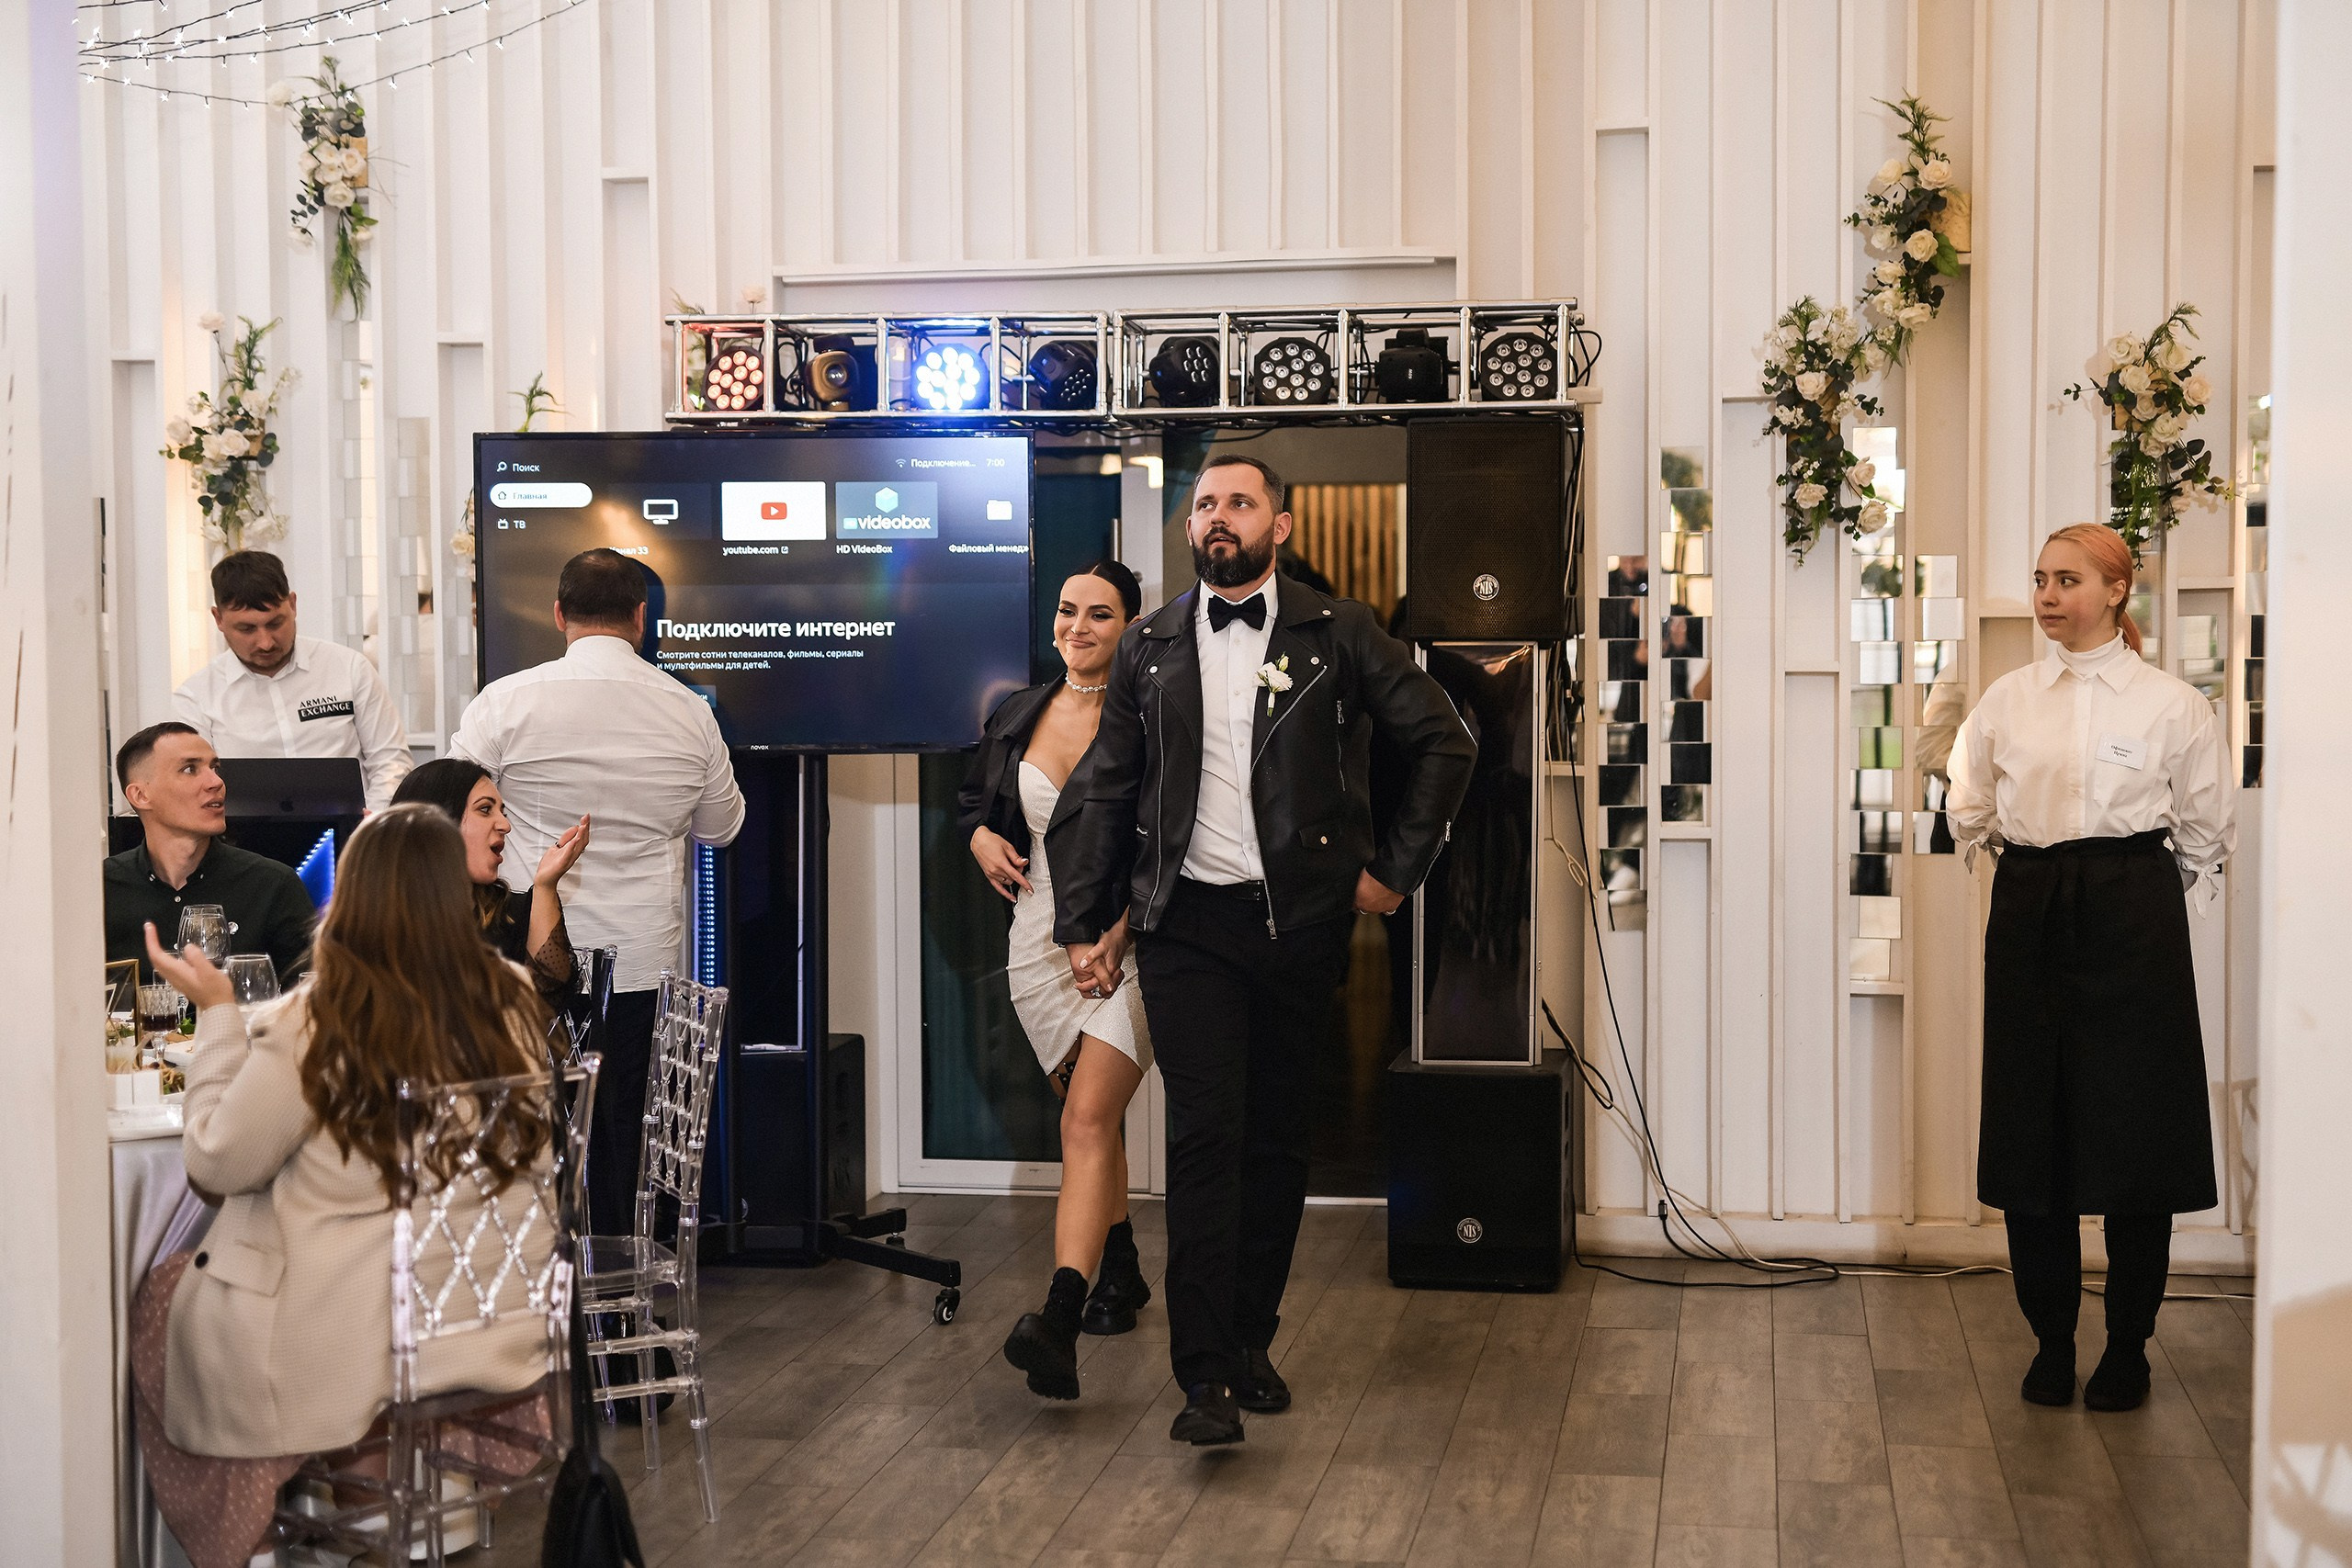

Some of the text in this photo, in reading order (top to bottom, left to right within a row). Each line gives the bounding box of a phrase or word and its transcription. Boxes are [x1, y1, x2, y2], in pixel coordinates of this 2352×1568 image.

[512, 463, 540, 473] Поиск
[986, 457, 1005, 468] 7:00
[513, 491, 548, 501] Главная
[513, 520, 526, 529] ТВ
[857, 514, 932, 530] videobox
[638, 546, 649, 555] 33
[722, 545, 779, 556] youtube.com
[836, 544, 893, 554] HD VideoBox
[948, 544, 994, 553] Файловый
[656, 619, 896, 641] Подключите интернет
[656, 650, 700, 660] Смотрите
[728, 650, 786, 660] телеканалов,
[787, 649, 825, 659] фильмы,
[826, 649, 864, 659] сериалы
[664, 660, 724, 671] мультфильмы
[725, 661, 741, 671] для
[742, 660, 771, 671] детей.
[300, 695, 337, 708] ARMANI
[300, 703, 350, 717] EXCHANGE
